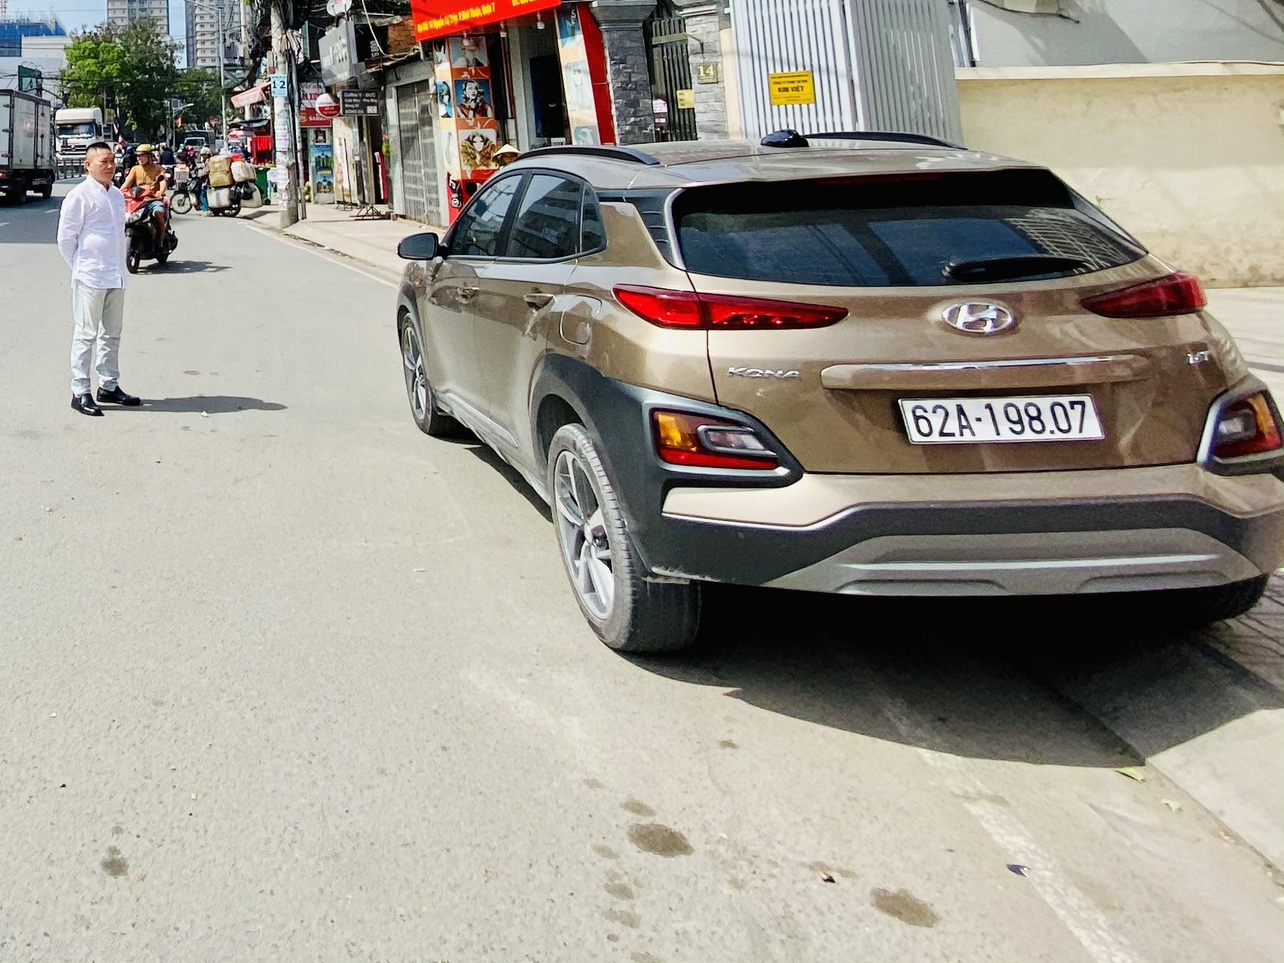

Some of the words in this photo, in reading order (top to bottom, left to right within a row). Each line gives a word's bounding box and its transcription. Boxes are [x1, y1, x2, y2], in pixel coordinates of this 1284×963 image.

[698, 64, 714, 77] 14
[728, 366, 800, 378] KONA
[911, 400, 1086, 438] 62A-198.07
